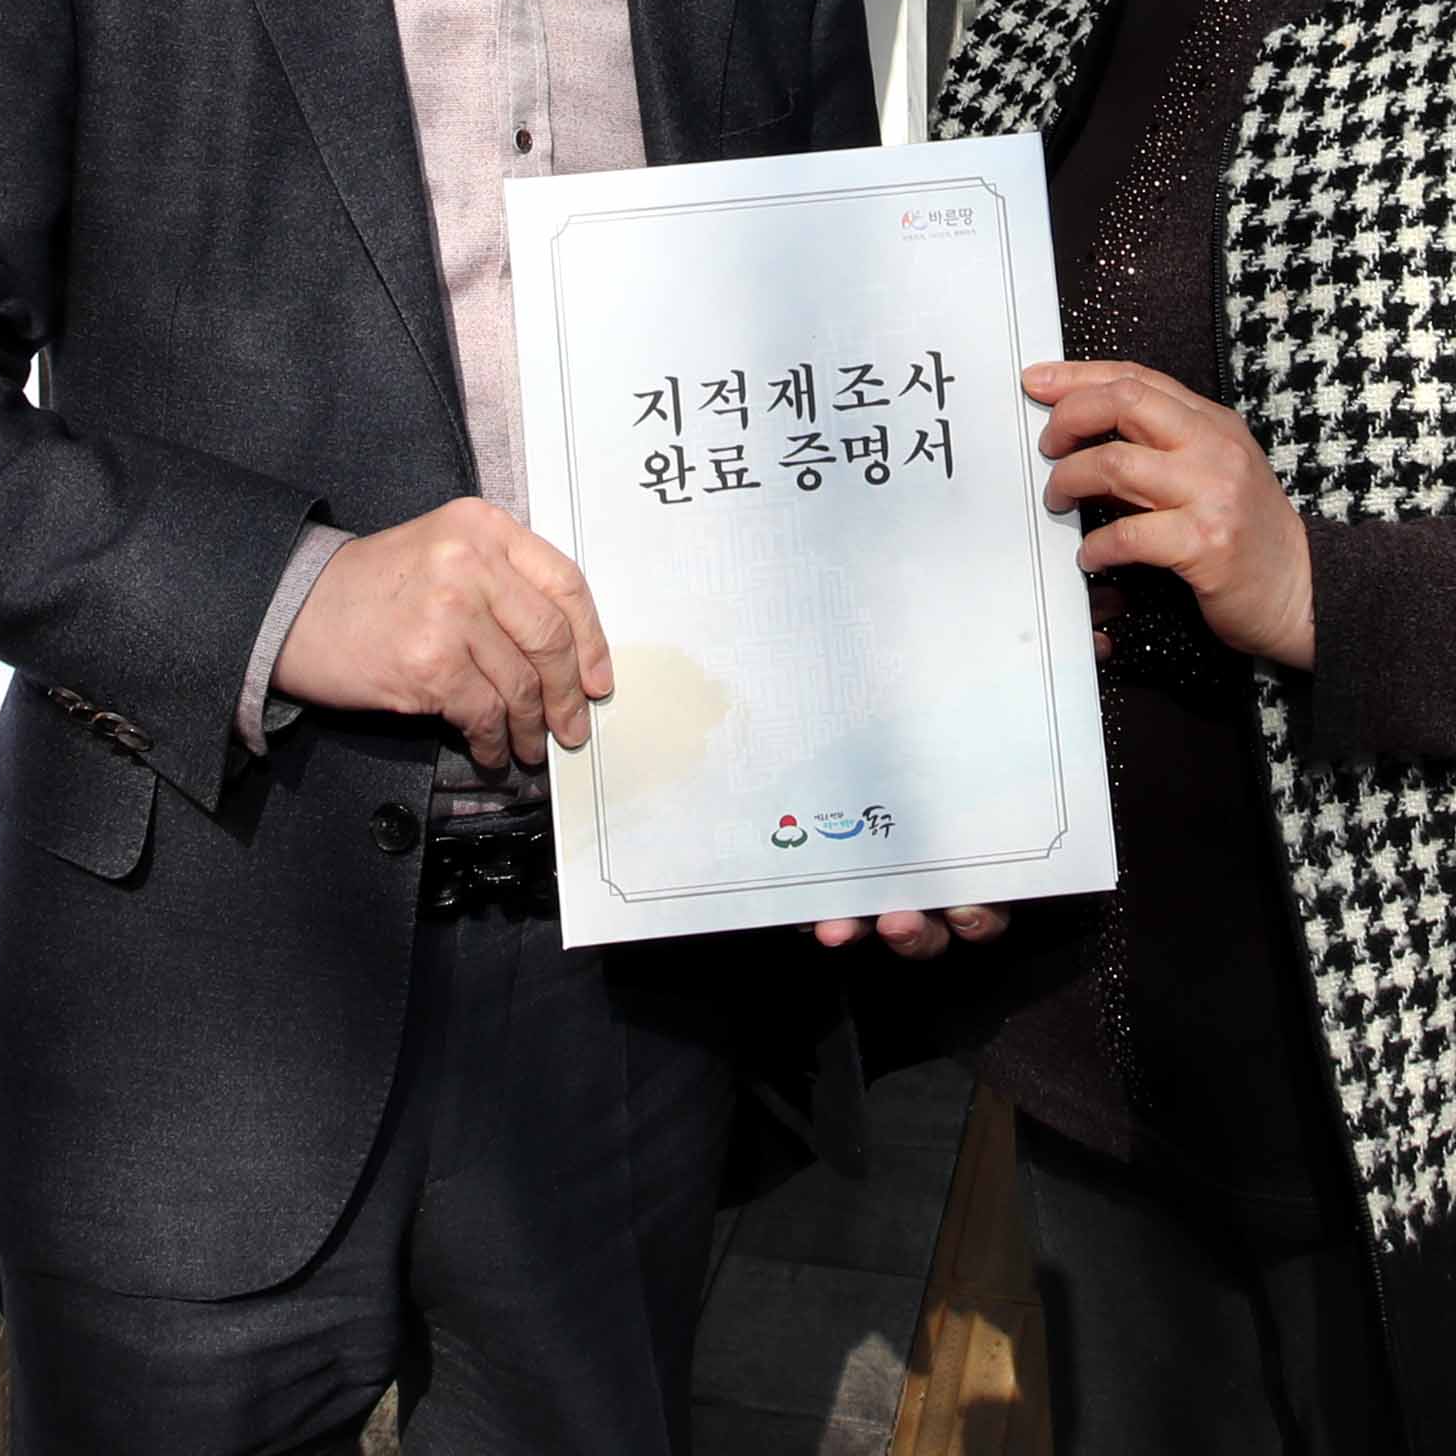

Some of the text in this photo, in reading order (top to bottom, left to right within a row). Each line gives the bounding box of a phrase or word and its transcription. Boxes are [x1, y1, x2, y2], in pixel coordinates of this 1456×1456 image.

[632, 351, 955, 436] 지적재조사
[638, 418, 955, 505] 완료 증명서
